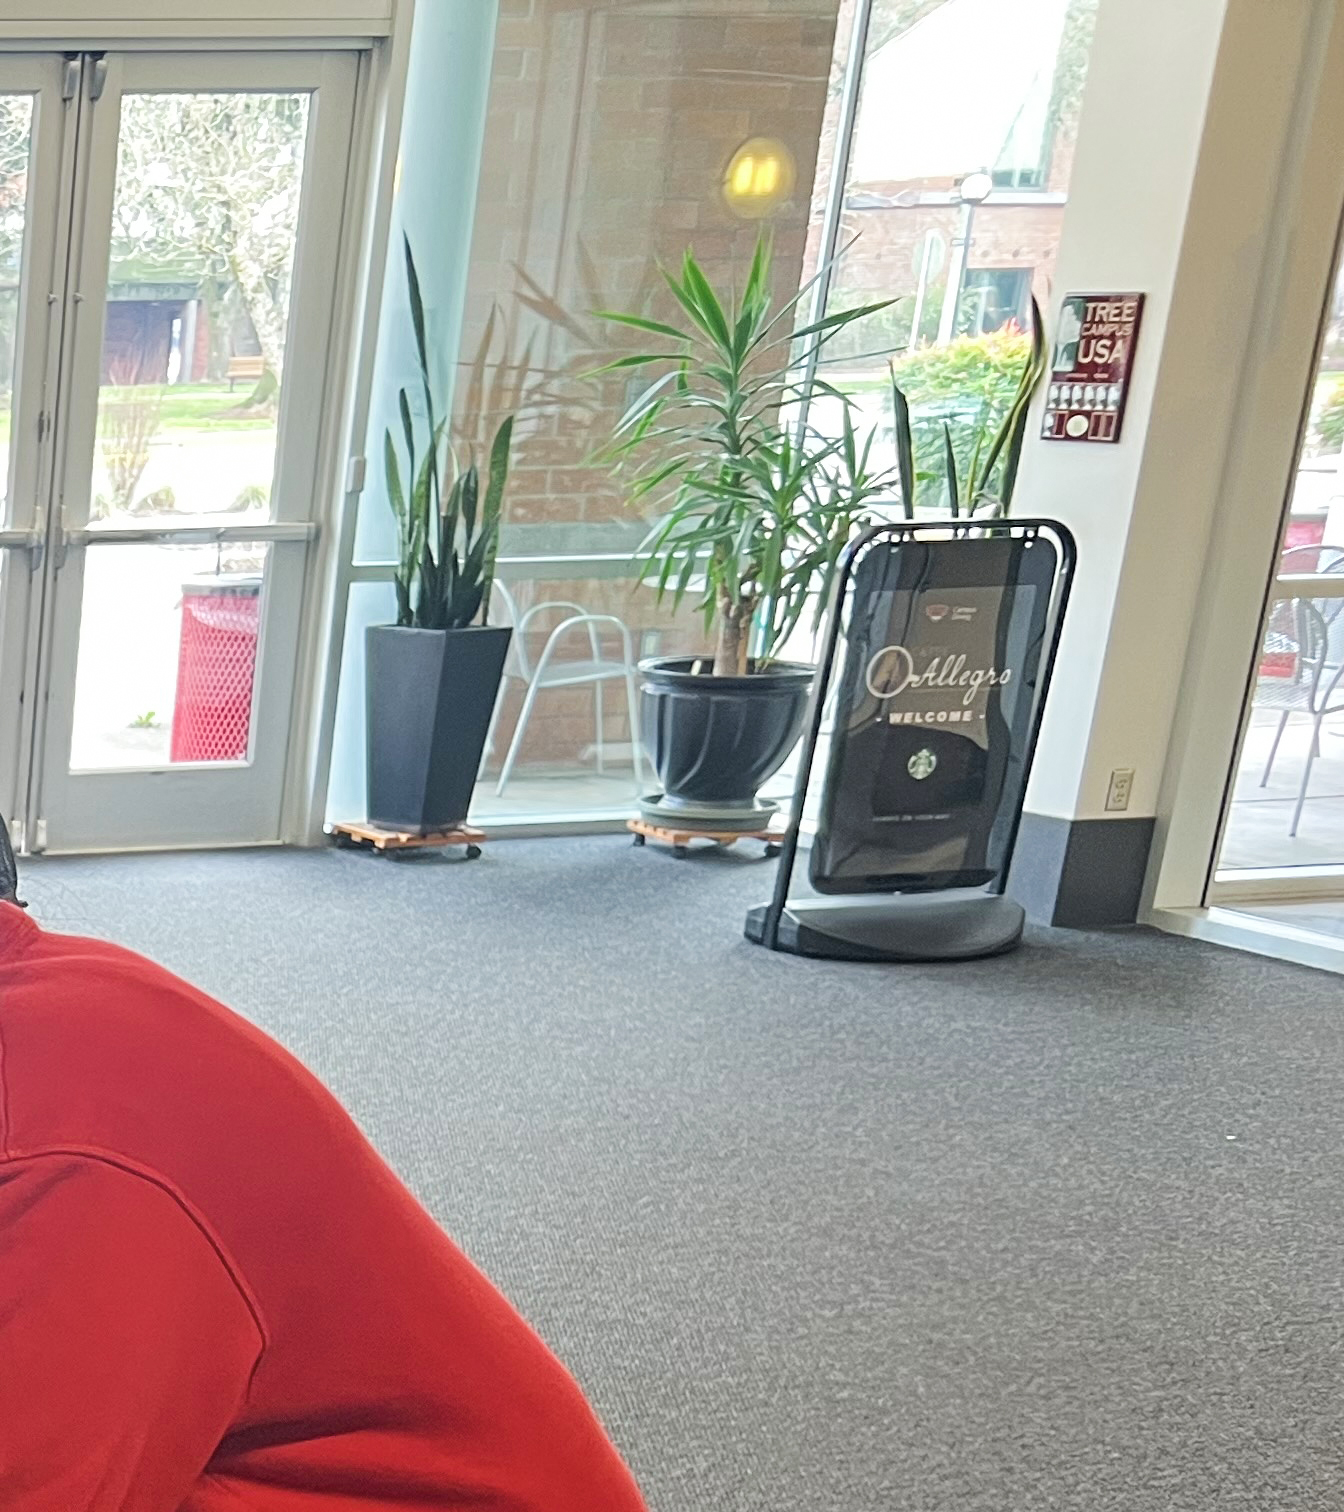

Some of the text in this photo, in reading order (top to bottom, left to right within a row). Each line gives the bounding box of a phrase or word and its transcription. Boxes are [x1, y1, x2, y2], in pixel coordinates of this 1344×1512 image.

[1086, 302, 1138, 322] TREE
[1081, 322, 1134, 337] CAMPUS
[1078, 339, 1124, 364] USA
[910, 654, 1012, 705] Allegro
[889, 711, 973, 724] WELCOME
